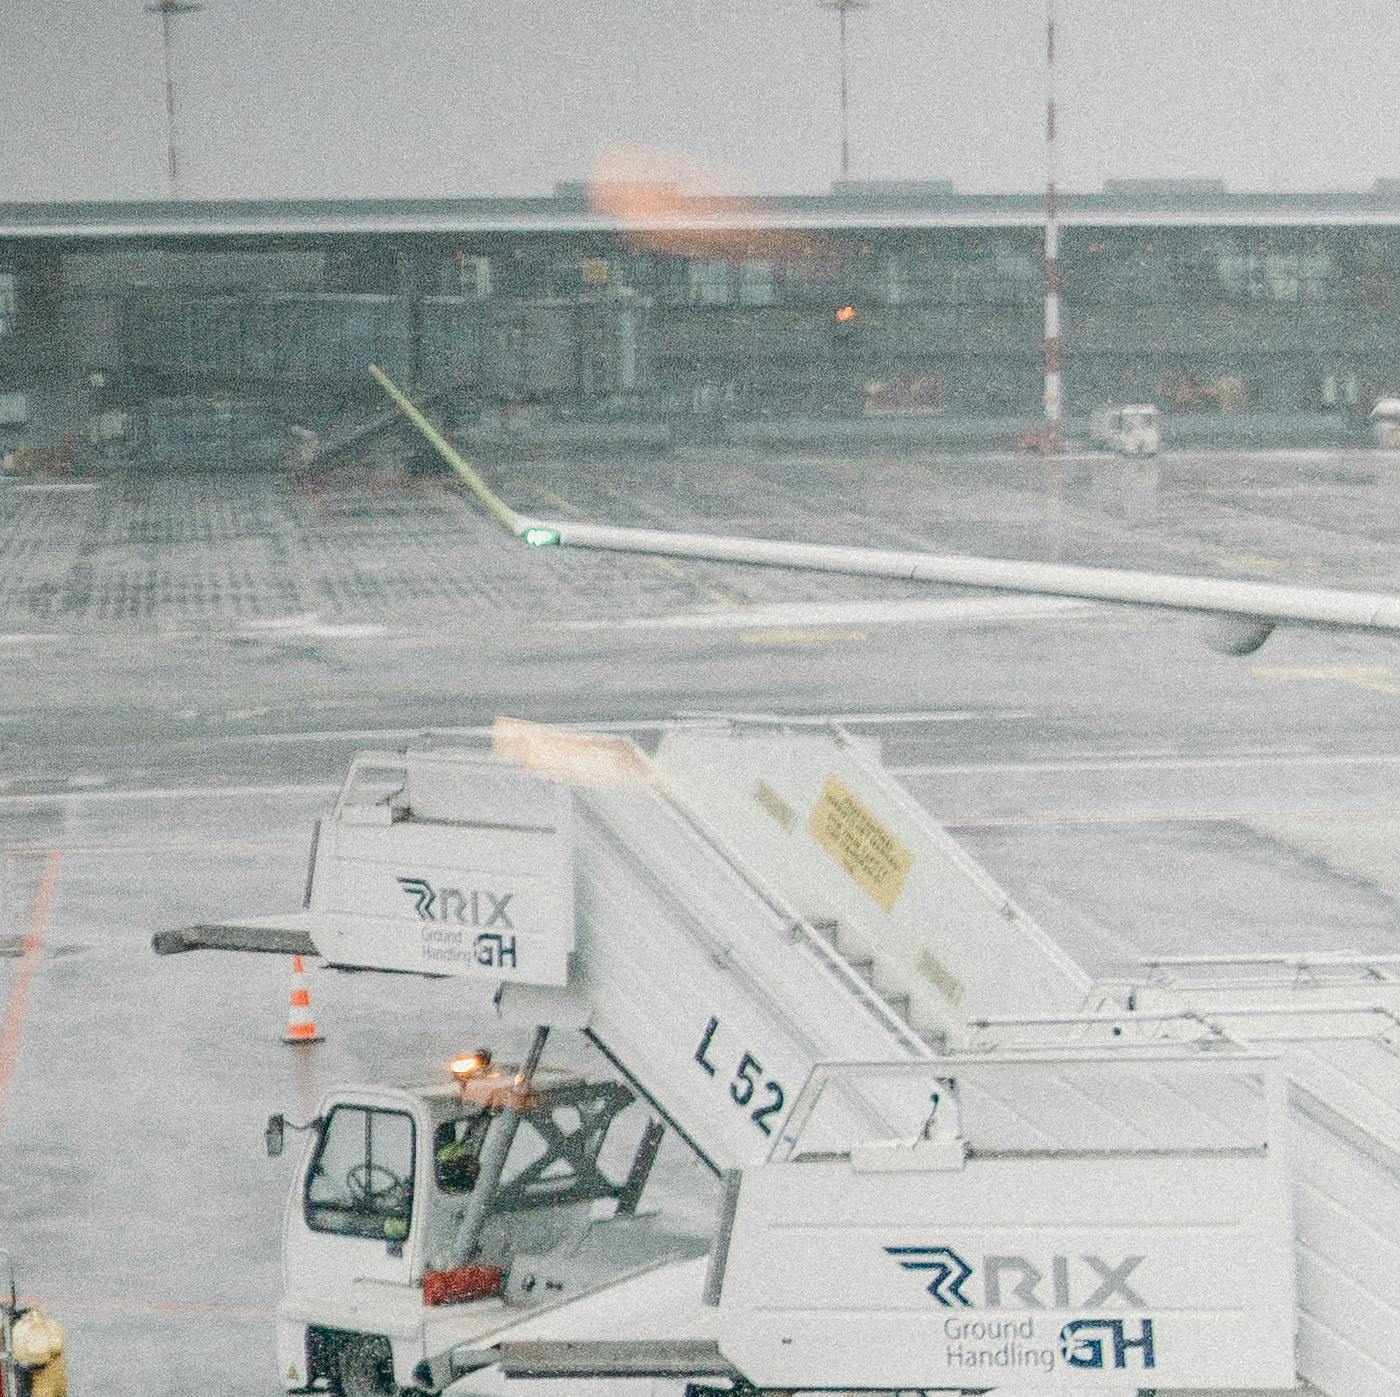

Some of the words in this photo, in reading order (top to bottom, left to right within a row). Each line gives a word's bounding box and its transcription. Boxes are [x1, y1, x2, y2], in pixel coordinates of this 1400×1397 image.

[440, 887, 514, 928] RIX
[473, 931, 517, 969] GH
[694, 1014, 719, 1077] L
[729, 1049, 785, 1138] 52
[982, 1255, 1149, 1309] RIX
[943, 1316, 1033, 1341] Ground
[1059, 1317, 1156, 1369] GH
[946, 1345, 1056, 1372] Handling
